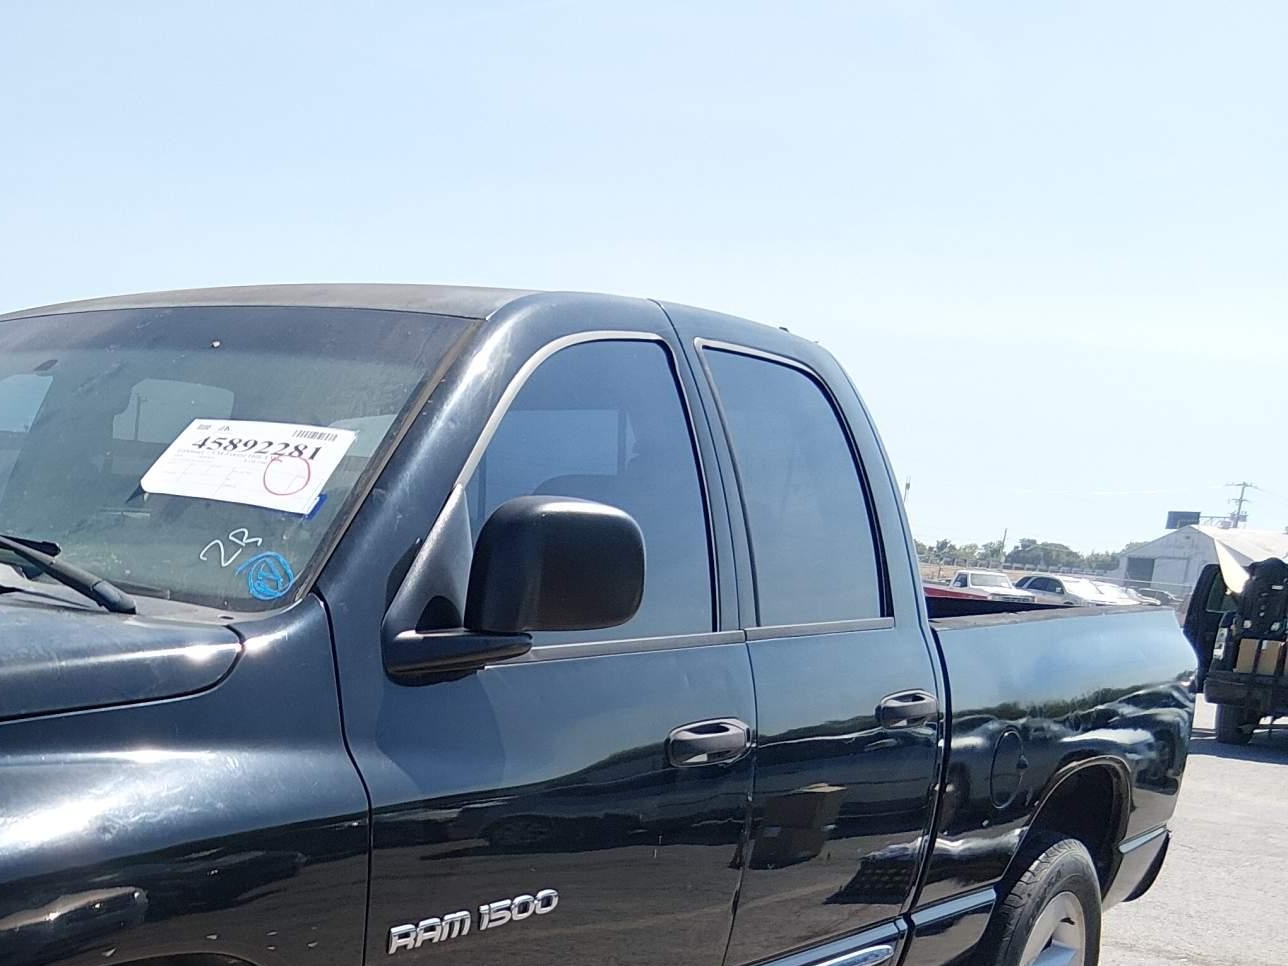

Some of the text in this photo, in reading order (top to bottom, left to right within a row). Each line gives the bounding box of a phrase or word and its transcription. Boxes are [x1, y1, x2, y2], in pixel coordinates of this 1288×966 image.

[192, 436, 323, 460] 45892281
[388, 888, 560, 955] RAM 1500
